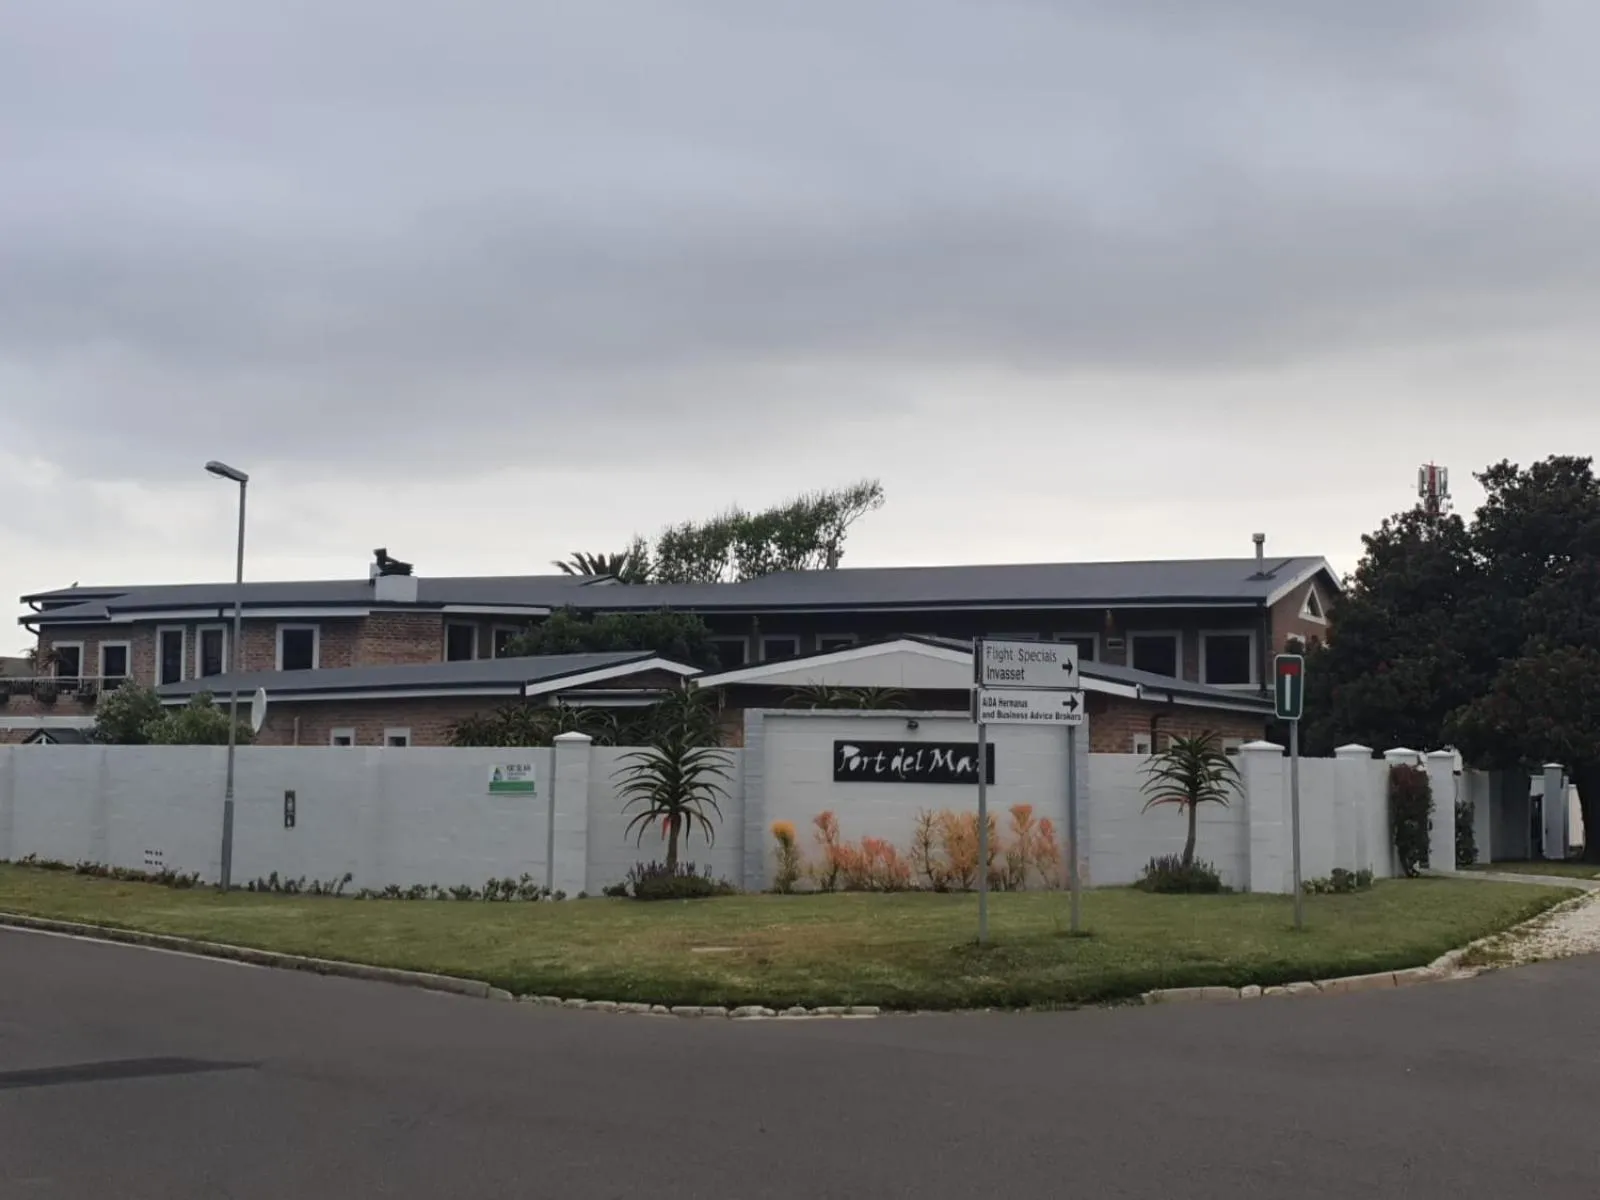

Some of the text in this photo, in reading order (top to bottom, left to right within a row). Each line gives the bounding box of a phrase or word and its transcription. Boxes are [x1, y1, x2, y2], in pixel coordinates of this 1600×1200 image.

[986, 645, 1057, 664] Flight Specials
[986, 664, 1025, 681] Invasset
[982, 710, 995, 719] and
[997, 709, 1028, 720] Business
[838, 745, 886, 773] Port
[891, 748, 923, 779] del
